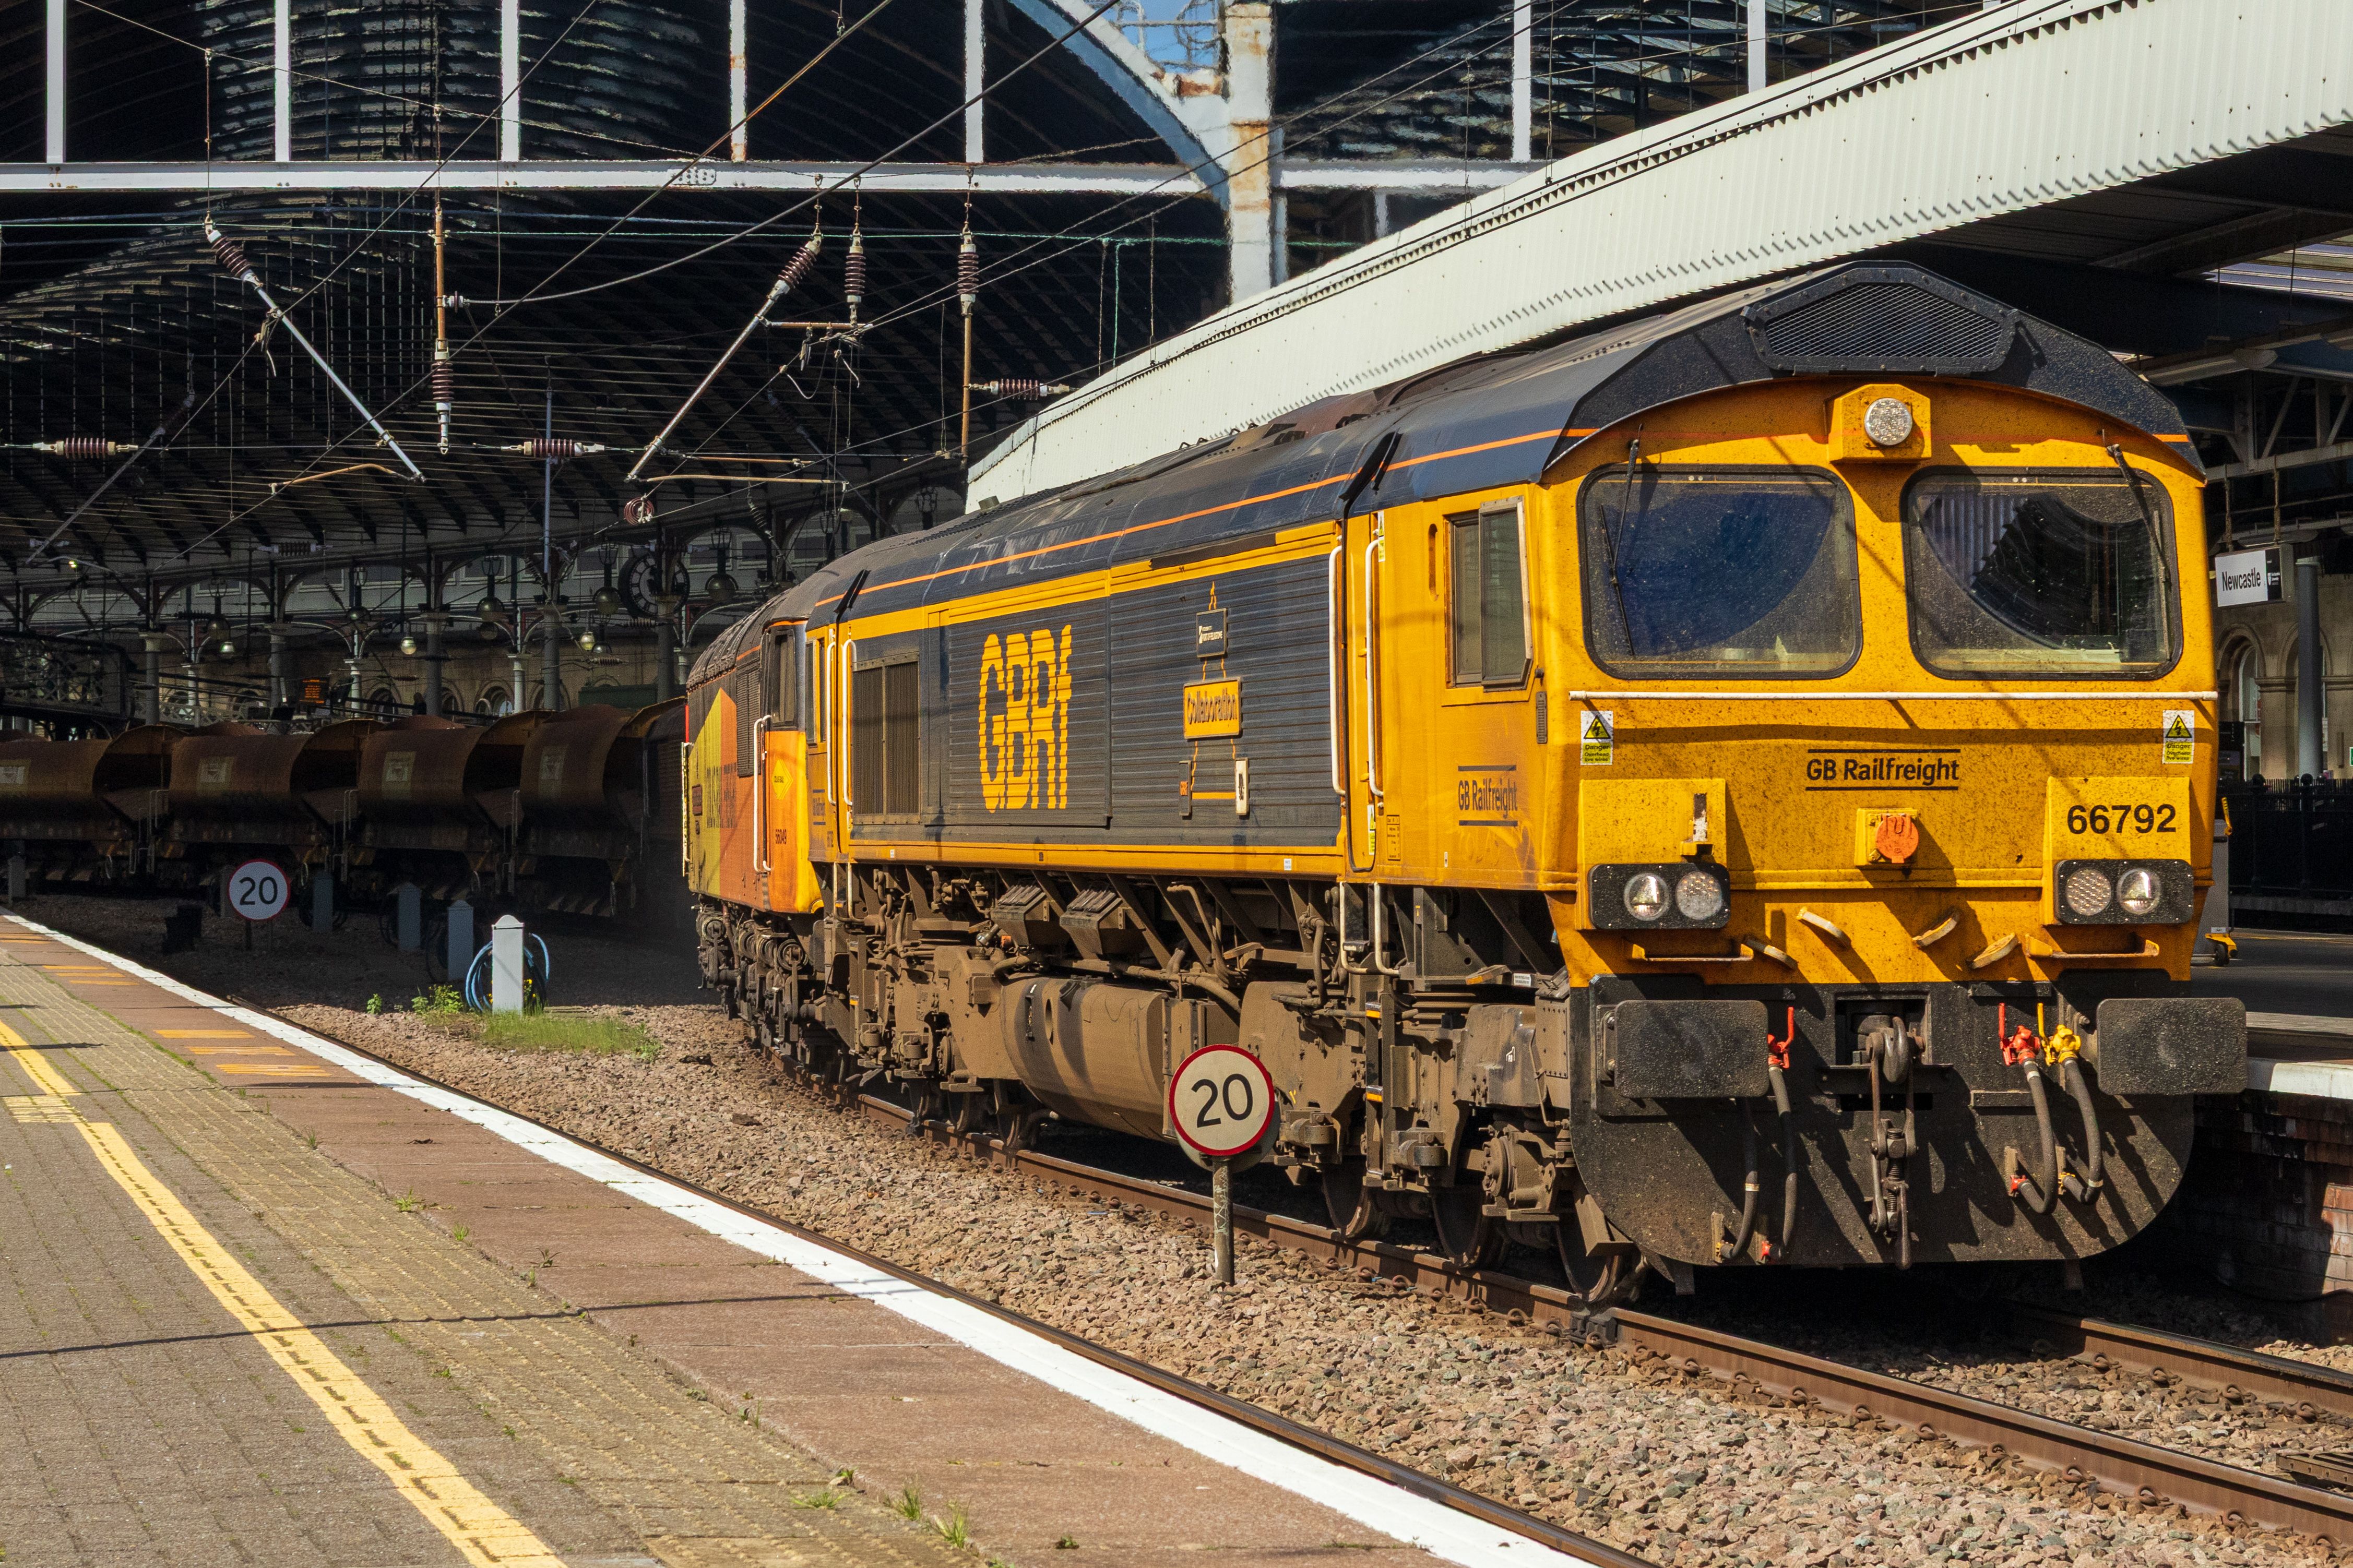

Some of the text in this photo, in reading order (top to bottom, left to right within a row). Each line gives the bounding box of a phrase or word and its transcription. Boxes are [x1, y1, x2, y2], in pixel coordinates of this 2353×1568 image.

[2221, 567, 2261, 592] Newcastle
[1187, 687, 1238, 725] Collaboration
[1807, 758, 1960, 786] GB Railfreight
[1458, 777, 1518, 819] GB Railfreight
[2066, 804, 2177, 835] 66792
[239, 876, 279, 906] 20
[1191, 1073, 1254, 1129] 20
